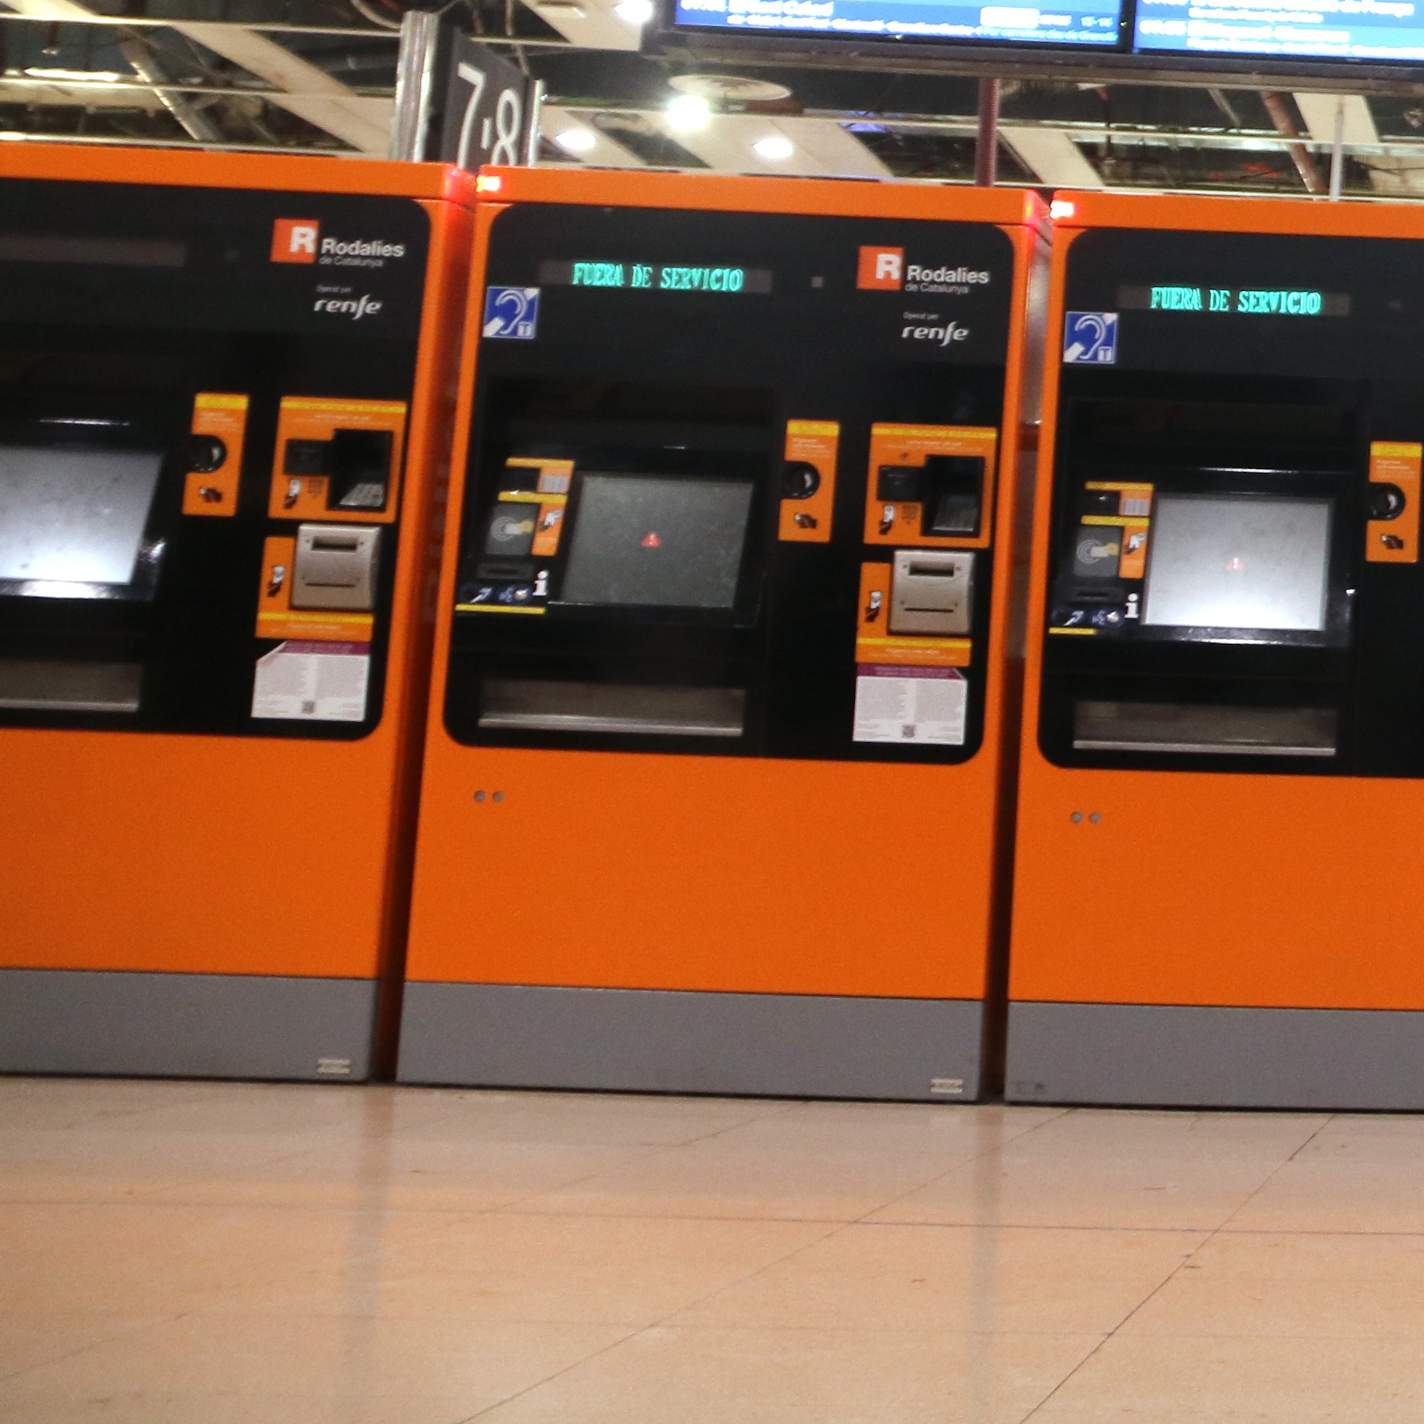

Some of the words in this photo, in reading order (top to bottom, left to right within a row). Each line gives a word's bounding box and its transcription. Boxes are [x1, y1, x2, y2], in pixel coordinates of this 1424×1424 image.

[290, 225, 317, 253] R
[321, 237, 405, 257] Rodalies
[572, 262, 624, 287] FUERA
[630, 263, 653, 289] DE
[659, 267, 745, 293] SERVICIO
[875, 253, 901, 280] R
[906, 264, 990, 284] Rodalies
[313, 294, 383, 320] renfe
[1150, 286, 1203, 311] FUERA
[1208, 288, 1232, 313] DE
[1237, 290, 1322, 315] SERVICIO
[901, 321, 970, 347] renfe
